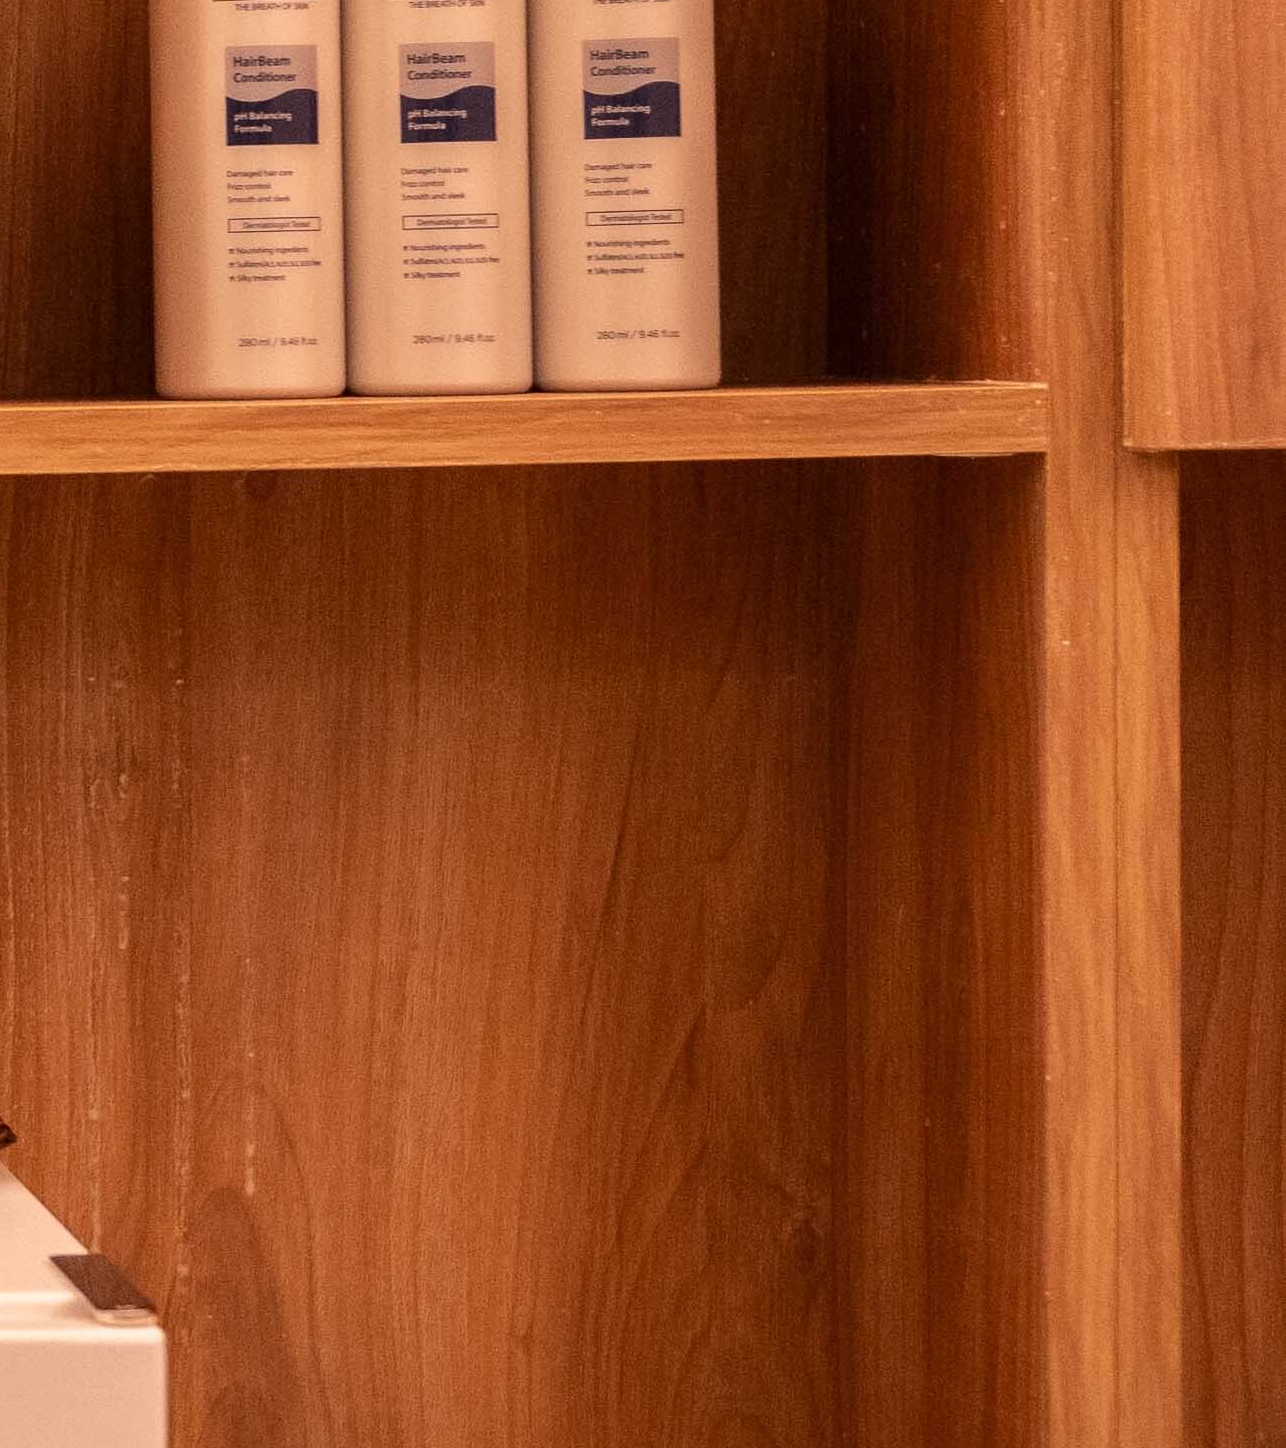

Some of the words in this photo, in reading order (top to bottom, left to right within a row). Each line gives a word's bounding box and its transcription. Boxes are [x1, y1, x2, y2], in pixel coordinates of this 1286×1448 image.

[406, 52, 466, 65] HairBeam
[589, 48, 650, 61] HairBeam
[232, 55, 292, 68] HairBeam
[406, 69, 473, 81] Conditioner
[589, 65, 657, 77] Conditioner
[232, 71, 298, 84] Conditioner
[233, 112, 249, 122] pH
[248, 111, 293, 122] Balancing
[407, 109, 422, 120] pH
[422, 108, 468, 119] Balancing
[590, 105, 605, 116] pH
[605, 105, 652, 115] Balancing
[407, 121, 447, 131] Formula
[590, 117, 630, 127] Formula
[234, 124, 273, 133] Formula
